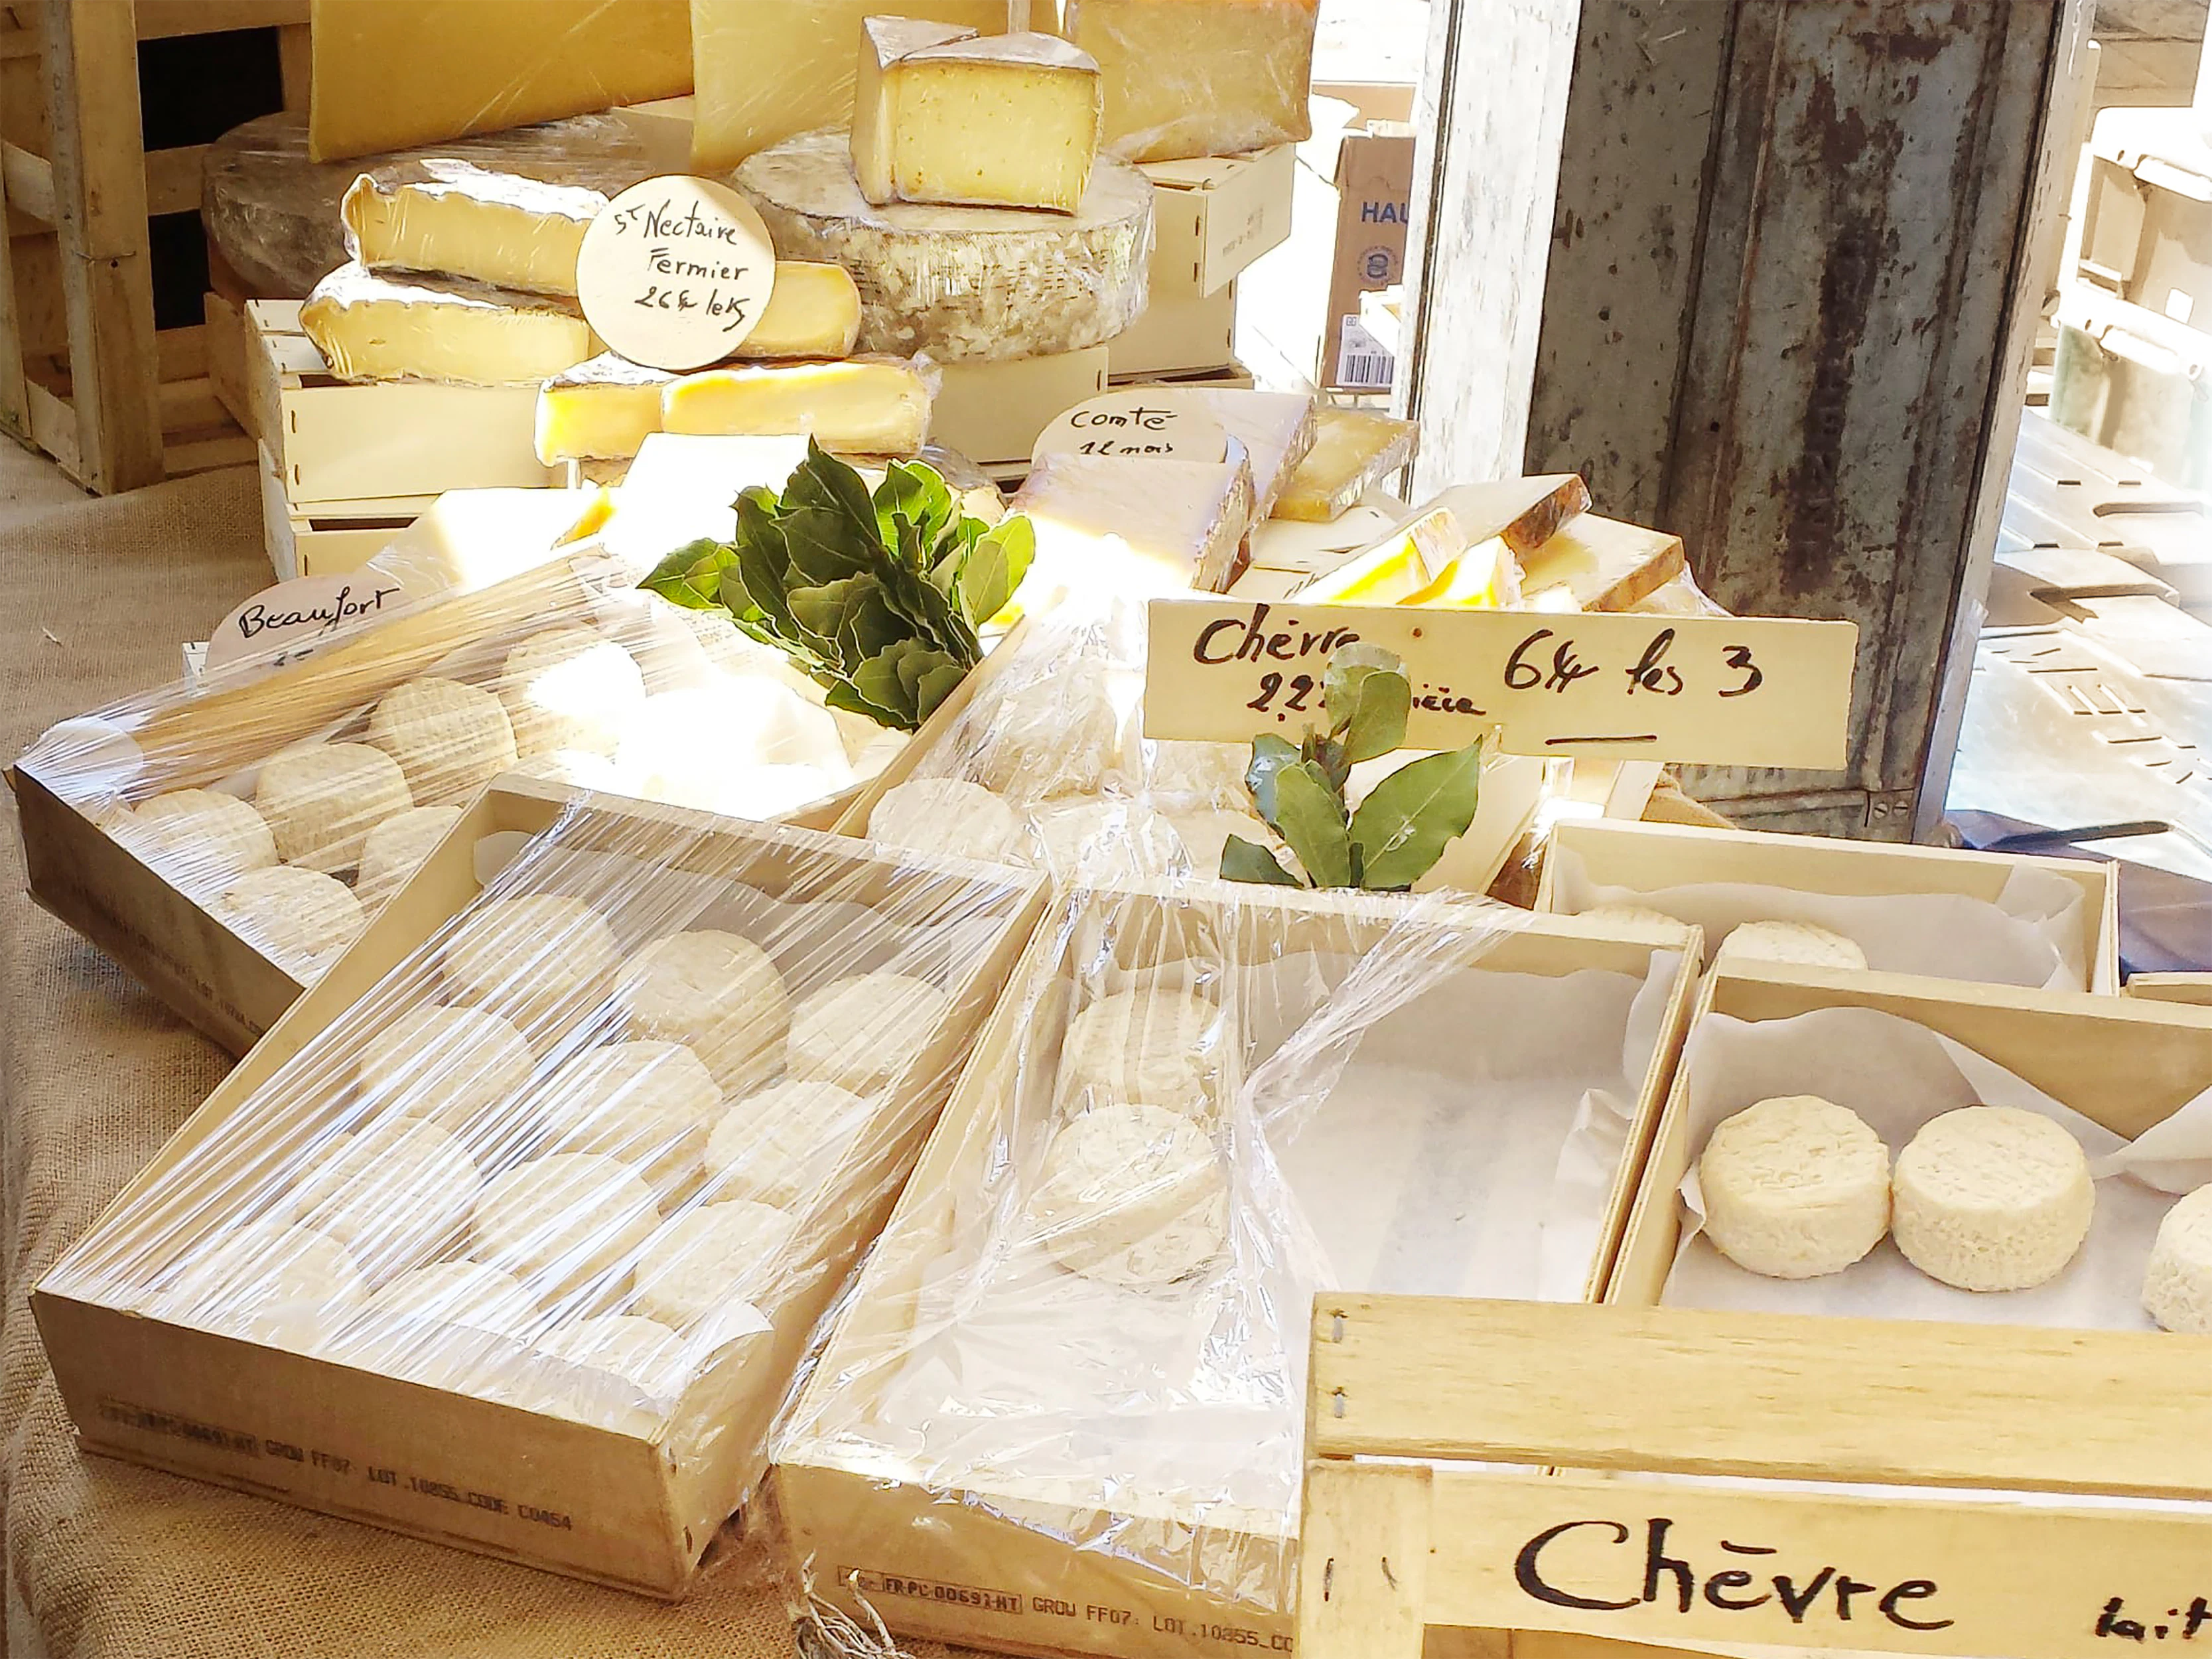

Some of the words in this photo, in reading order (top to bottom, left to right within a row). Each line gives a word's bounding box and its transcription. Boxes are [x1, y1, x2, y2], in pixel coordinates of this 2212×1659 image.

[644, 198, 737, 246] Nectaire
[648, 248, 748, 281] Fermier
[1070, 406, 1178, 431] Comté
[238, 586, 400, 638] Beaufort
[1625, 627, 1684, 695] les
[1718, 644, 1763, 698] 3
[1514, 1516, 1954, 1631] Chèvre
